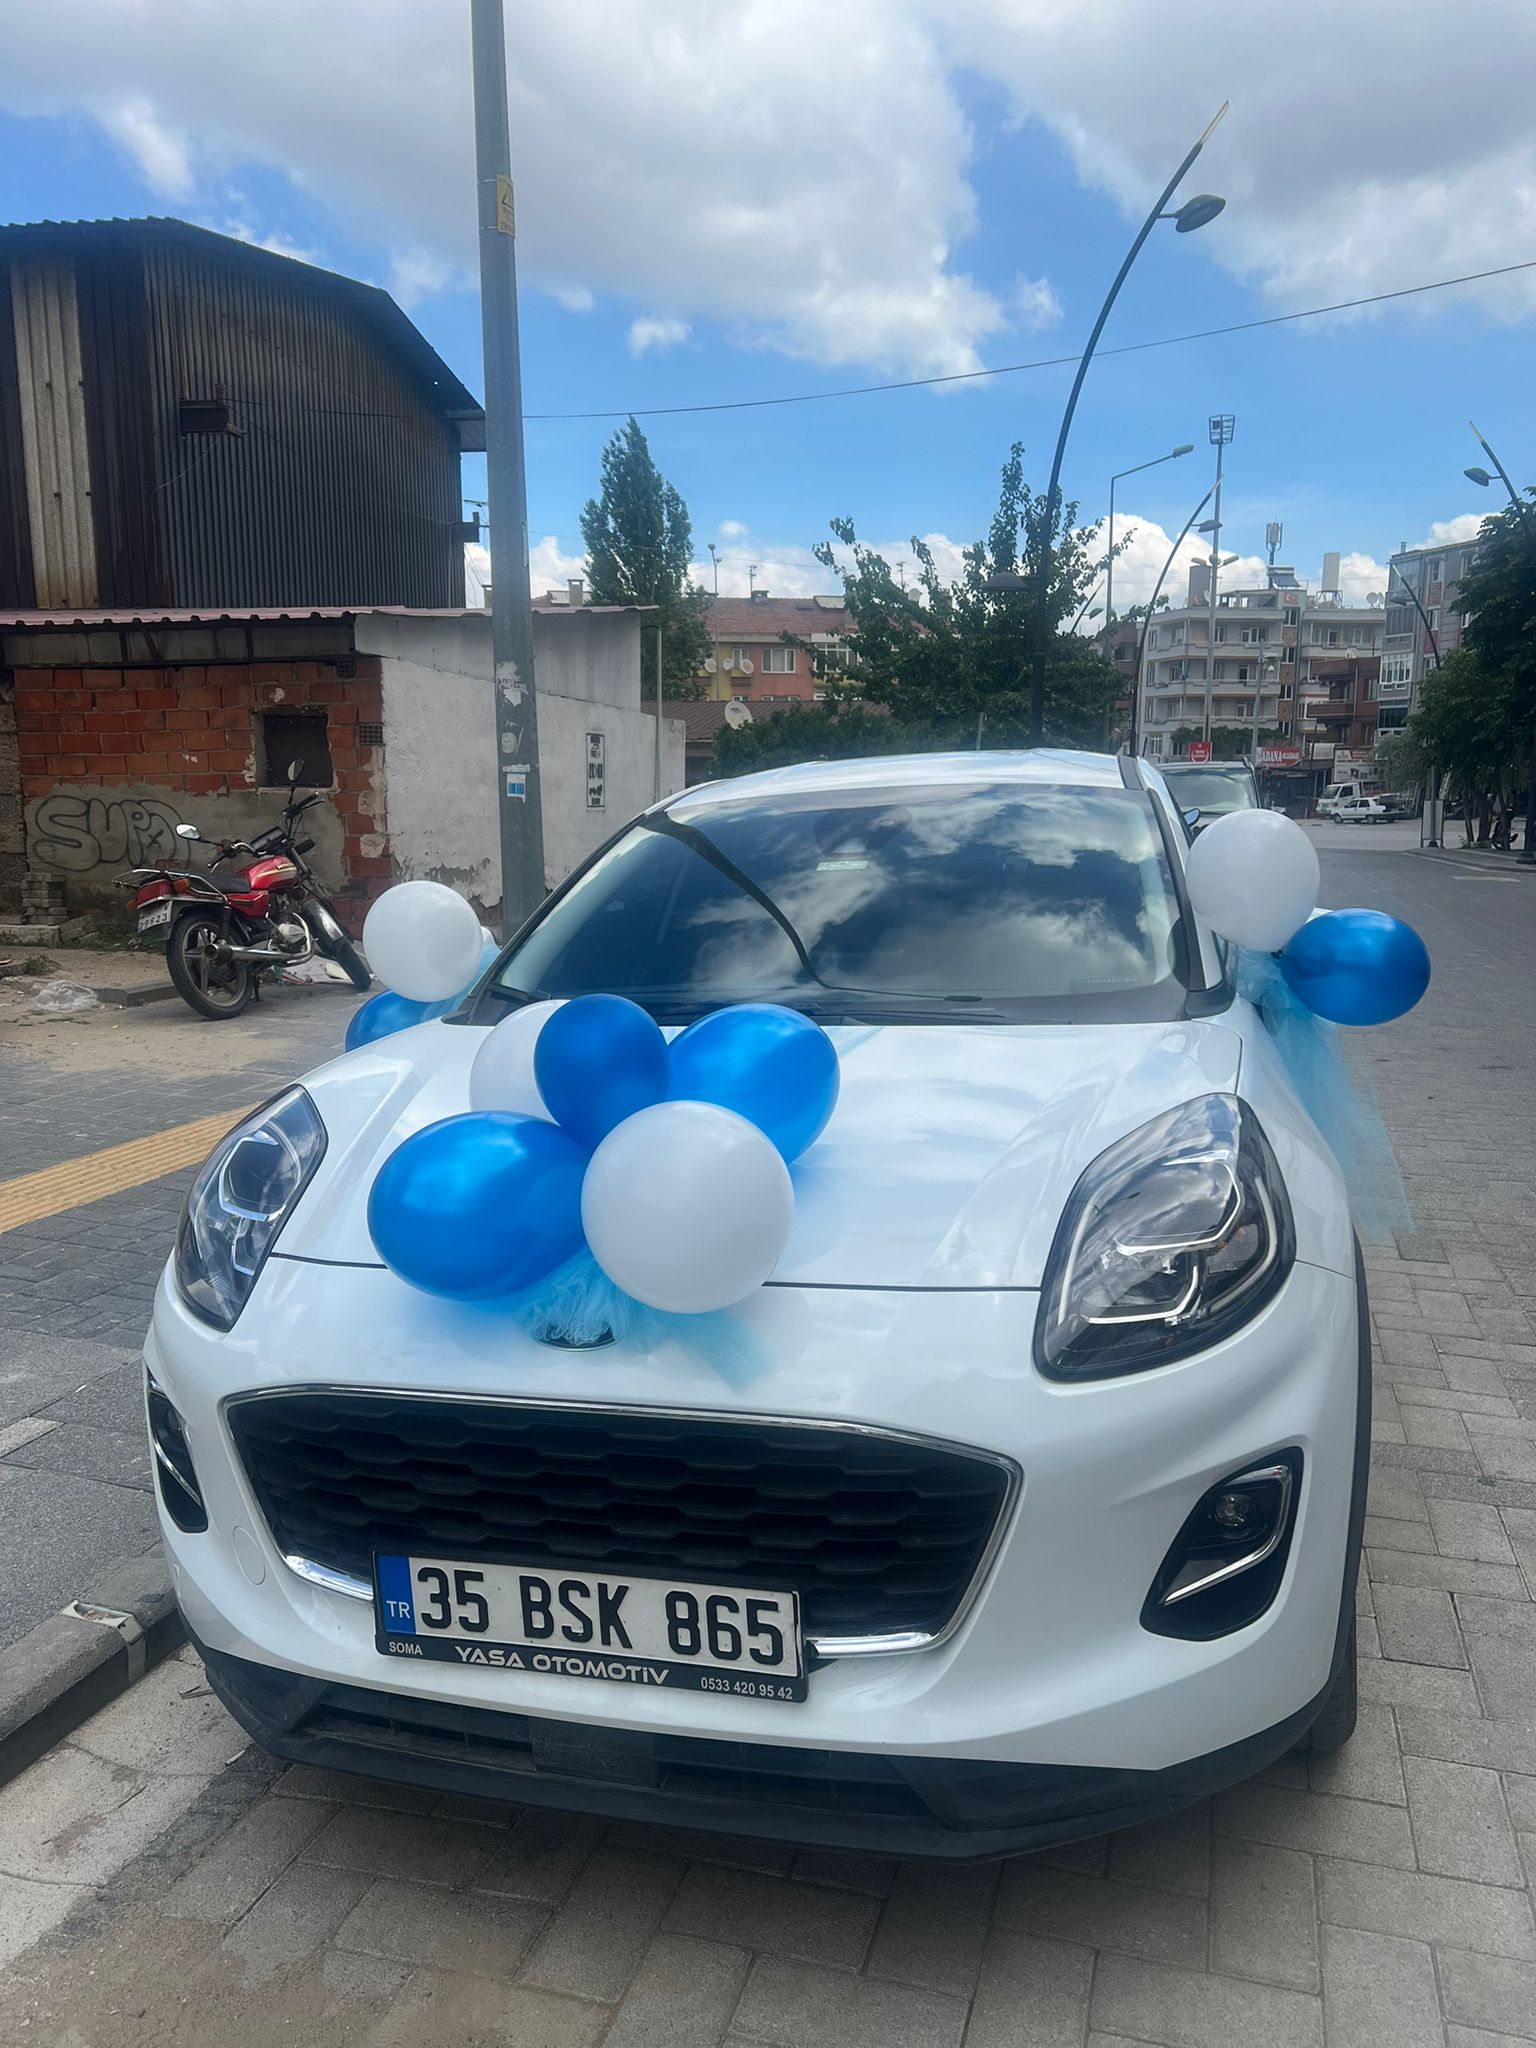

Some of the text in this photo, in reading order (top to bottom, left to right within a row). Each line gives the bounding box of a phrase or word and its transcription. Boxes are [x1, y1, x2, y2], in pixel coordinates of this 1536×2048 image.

[386, 1600, 411, 1619] TR
[417, 1567, 784, 1666] 35 BSK 865
[389, 1641, 423, 1656] SOMA
[454, 1646, 526, 1669] YASA
[700, 1676, 793, 1700] 0533 420 95 42
